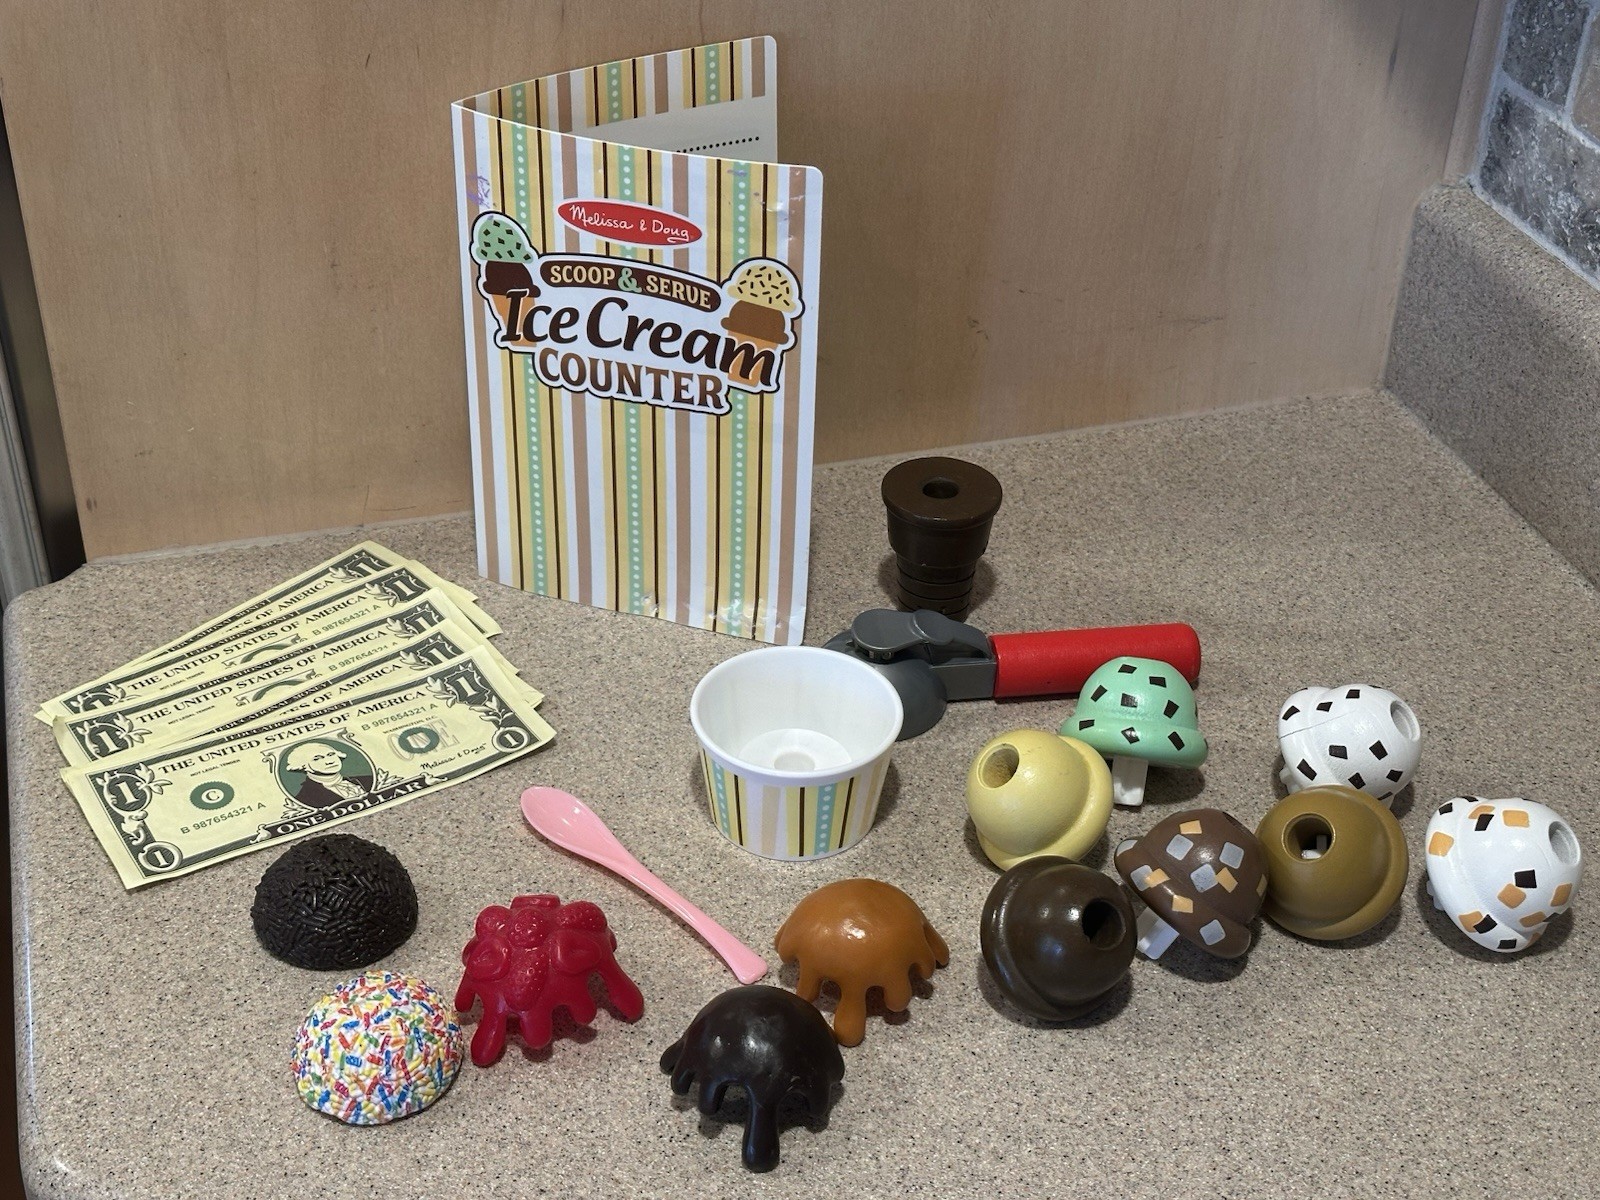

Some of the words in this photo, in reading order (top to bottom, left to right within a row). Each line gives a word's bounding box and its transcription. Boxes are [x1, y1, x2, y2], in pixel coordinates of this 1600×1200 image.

[569, 204, 634, 230] Melissa
[640, 219, 646, 231] &
[652, 218, 690, 243] Doug
[550, 265, 616, 285] SCOOP
[617, 268, 642, 293] &
[646, 276, 712, 308] SERVE
[501, 289, 579, 343] Ice
[586, 297, 775, 387] Cream
[538, 347, 725, 409] COUNTER
[255, 608, 274, 620] OF
[278, 578, 334, 611] AMERICA
[394, 580, 416, 597] 1
[312, 628, 321, 636] B
[322, 608, 371, 632] 987654321
[127, 675, 162, 691] THE
[162, 652, 220, 678] UNITED
[223, 630, 278, 655] STATES
[280, 621, 300, 633] OF
[305, 594, 368, 624] AMERICA
[135, 707, 171, 724] THE
[173, 685, 232, 711] UNITED
[236, 660, 294, 689] STATES
[296, 654, 317, 668] OF
[322, 629, 388, 658] AMERICA
[329, 662, 337, 671] B
[312, 693, 333, 708] OF
[338, 663, 402, 694] AMERICA
[457, 676, 478, 697] 1
[159, 759, 195, 774] THE
[198, 740, 261, 763] UNITED
[265, 719, 326, 744] STATES
[329, 713, 350, 725] OF
[356, 689, 426, 717] AMERICA
[361, 723, 371, 731] B
[372, 707, 426, 729] 987654321
[97, 731, 119, 752] 1
[505, 734, 519, 747] 1
[420, 756, 456, 770] Melissa
[116, 782, 138, 804] 1
[205, 790, 220, 801] C
[277, 814, 326, 834] ONE
[331, 781, 422, 818] DOLLAR
[181, 826, 191, 834] B
[193, 807, 253, 831] 987654321
[257, 802, 266, 810] A
[153, 851, 168, 866] 1
